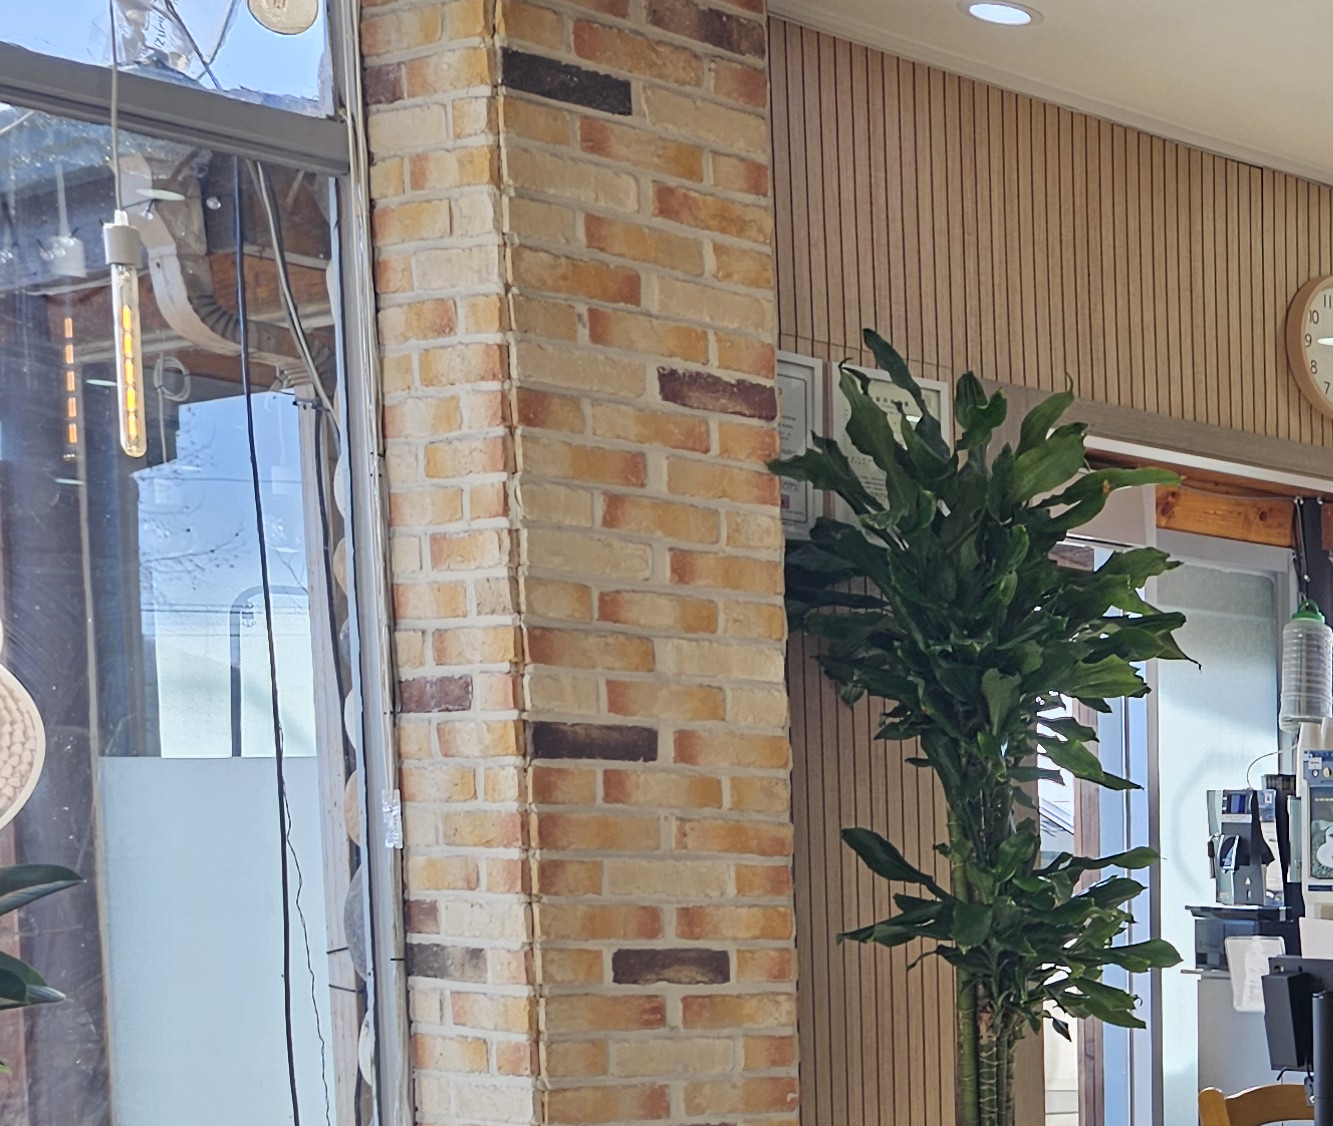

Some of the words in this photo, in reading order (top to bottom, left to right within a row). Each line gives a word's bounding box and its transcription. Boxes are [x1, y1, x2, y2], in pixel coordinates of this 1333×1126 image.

[1323, 294, 1332, 309] 11
[1309, 310, 1320, 325] 10
[1304, 334, 1312, 348] 9
[1310, 360, 1318, 374] 8
[1323, 381, 1331, 396] 7
